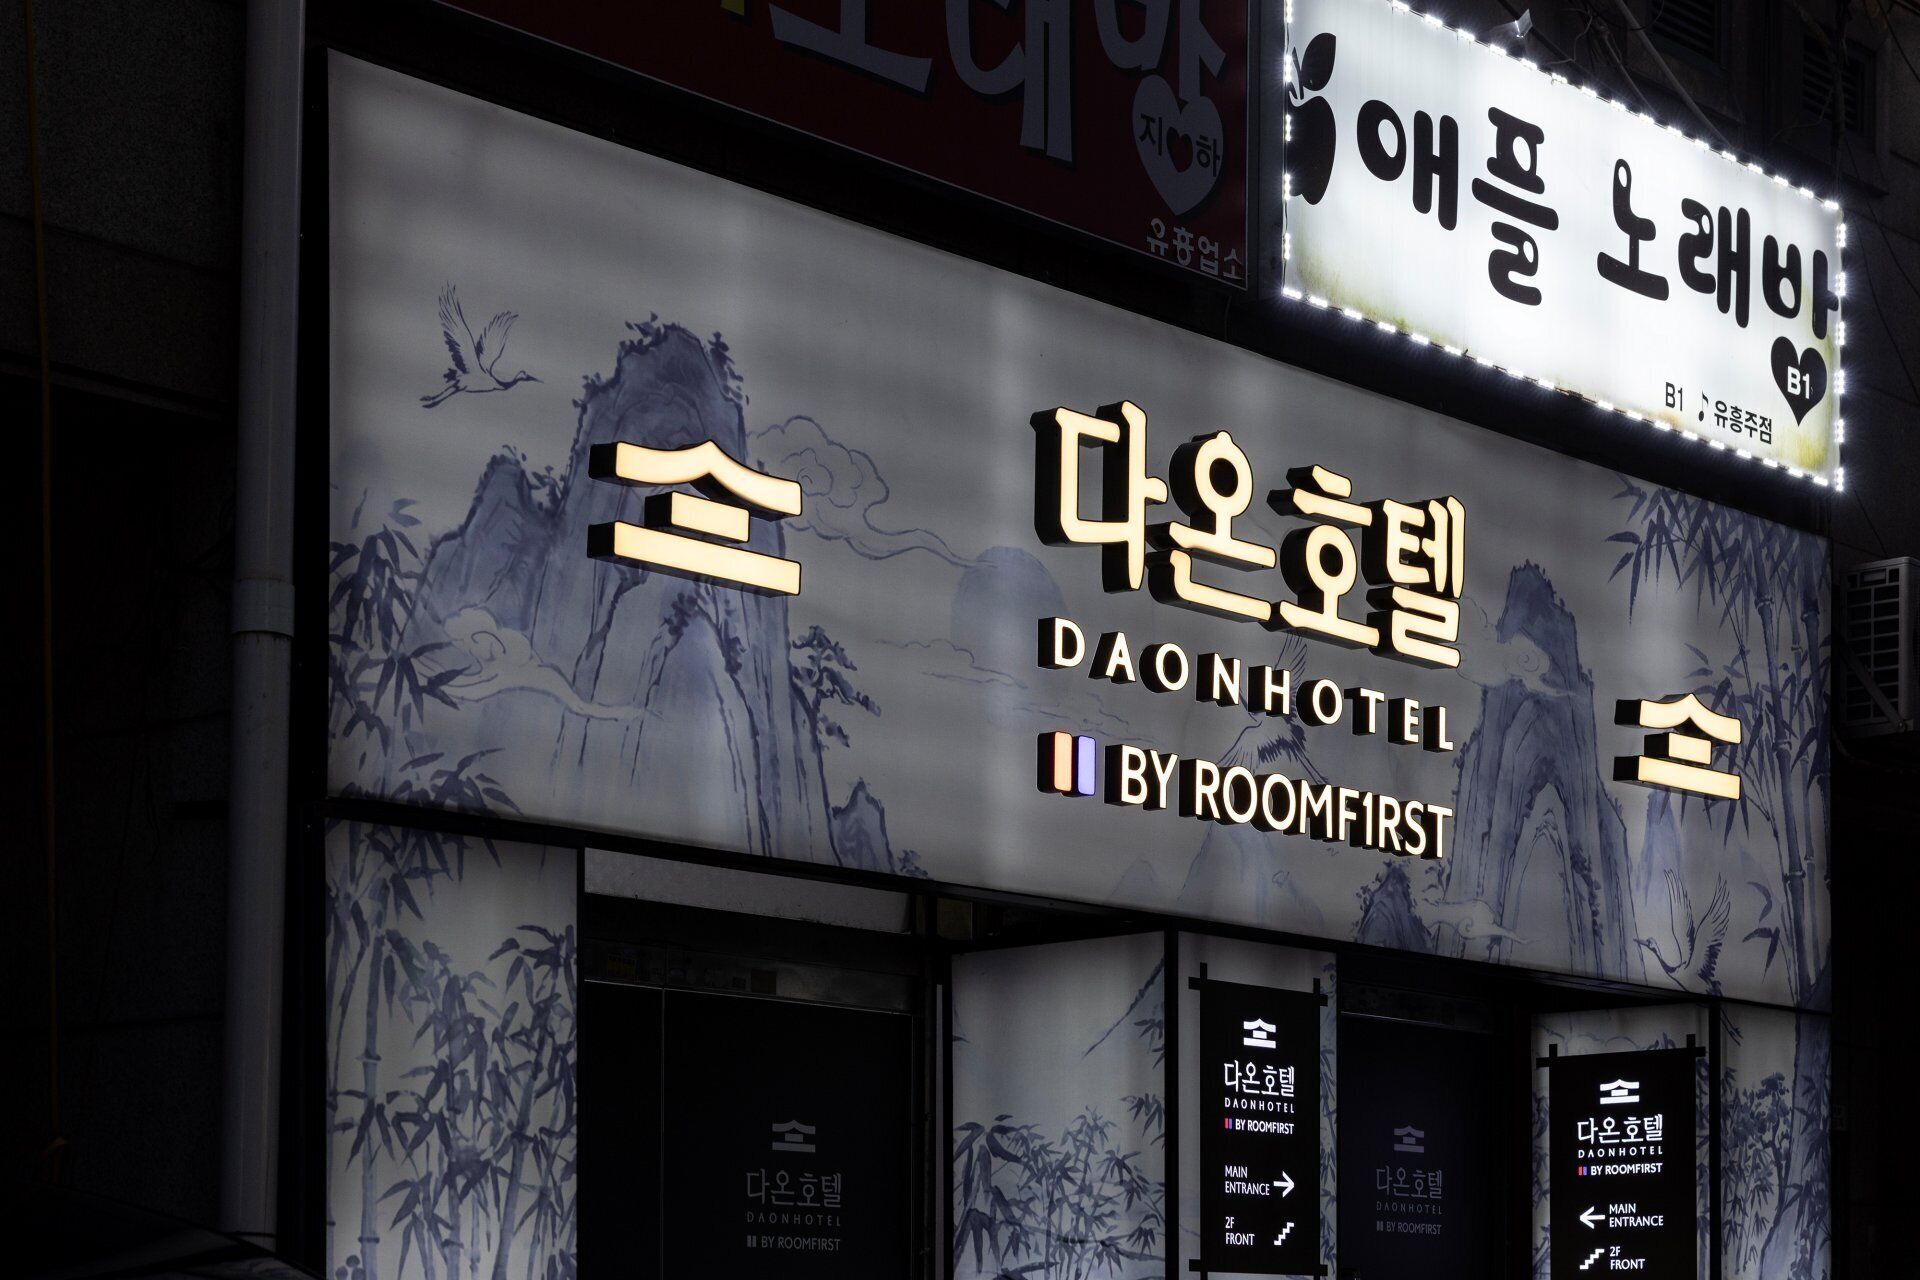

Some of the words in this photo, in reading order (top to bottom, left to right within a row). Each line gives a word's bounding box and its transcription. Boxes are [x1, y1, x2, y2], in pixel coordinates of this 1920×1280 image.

[1356, 99, 1559, 306] 애플
[1786, 365, 1811, 399] B1
[1665, 381, 1683, 411] B1
[1714, 400, 1772, 444] 유흥주점
[1050, 399, 1466, 669] 다온호텔
[1050, 617, 1454, 752] DAONHOTEL
[1118, 744, 1179, 809] BY
[1224, 1060, 1295, 1097] 다온호텔
[1224, 1097, 1295, 1114] DAONHOTEL
[1235, 1118, 1246, 1131] BY
[1577, 1113, 1663, 1144] 다온호텔
[1578, 1145, 1663, 1159] DAONHOTEL
[1224, 1165, 1248, 1178] MAIN
[1590, 1165, 1603, 1176] BY
[746, 1168, 842, 1208] 다온호텔
[1224, 1181, 1270, 1196] ENTRANCE
[1376, 1165, 1443, 1199] 다온호텔
[1376, 1200, 1442, 1215] DAONHOTEL
[1609, 1203, 1637, 1214] MAIN
[746, 1211, 841, 1227] DAONHOTEL
[1225, 1216, 1235, 1229] 2F
[1386, 1220, 1396, 1232] BY
[1609, 1215, 1664, 1228] ENTRANCE
[761, 1236, 775, 1249] BY
[1225, 1231, 1255, 1246] FRONT
[1609, 1246, 1621, 1257] 2F
[1610, 1258, 1646, 1270] FRONT
